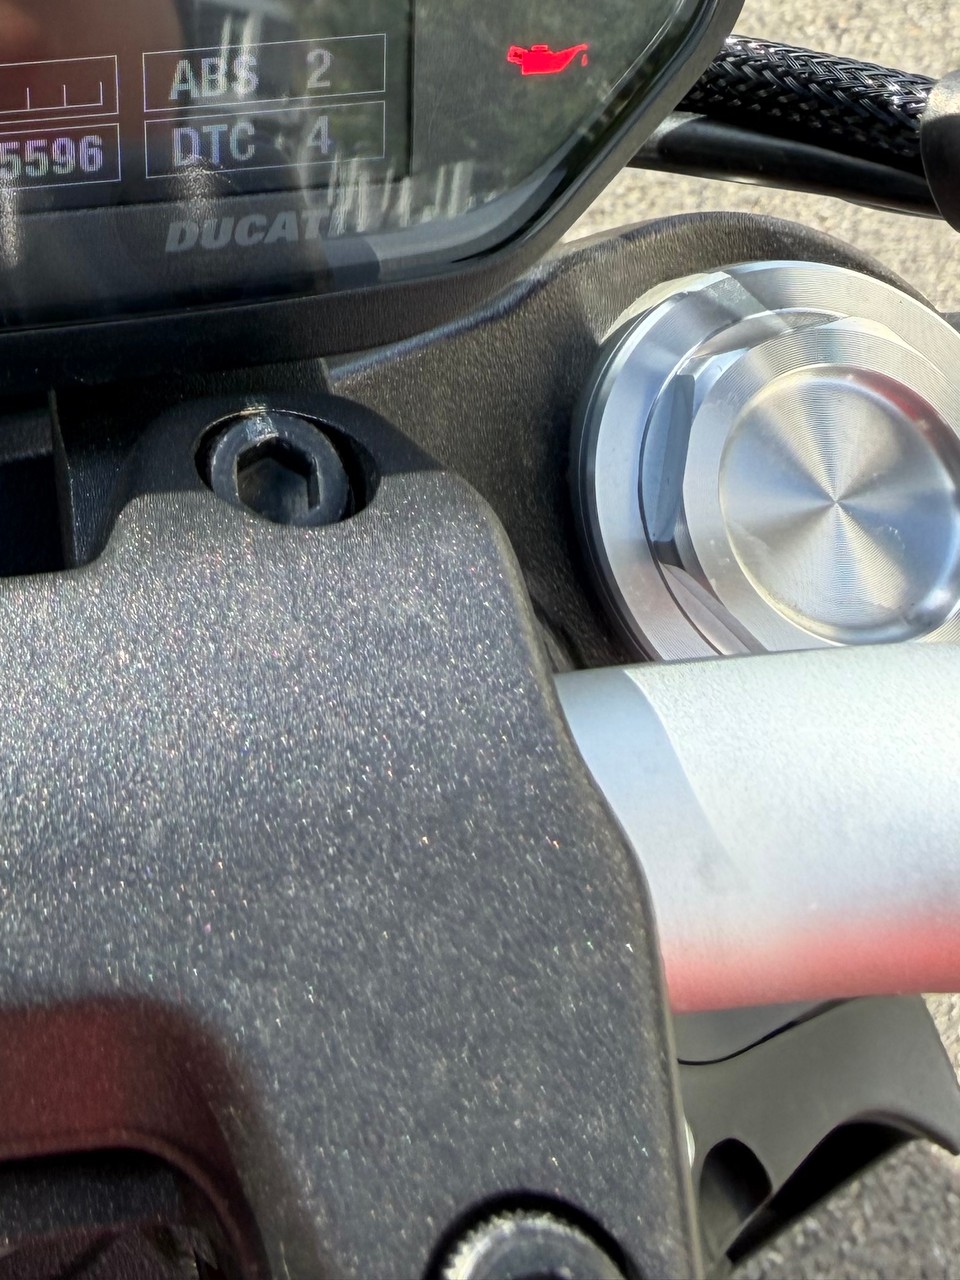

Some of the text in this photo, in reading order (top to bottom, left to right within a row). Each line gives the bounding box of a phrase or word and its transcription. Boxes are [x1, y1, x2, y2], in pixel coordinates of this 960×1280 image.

[171, 49, 332, 101] ABS 2
[172, 116, 331, 168] DTC 4
